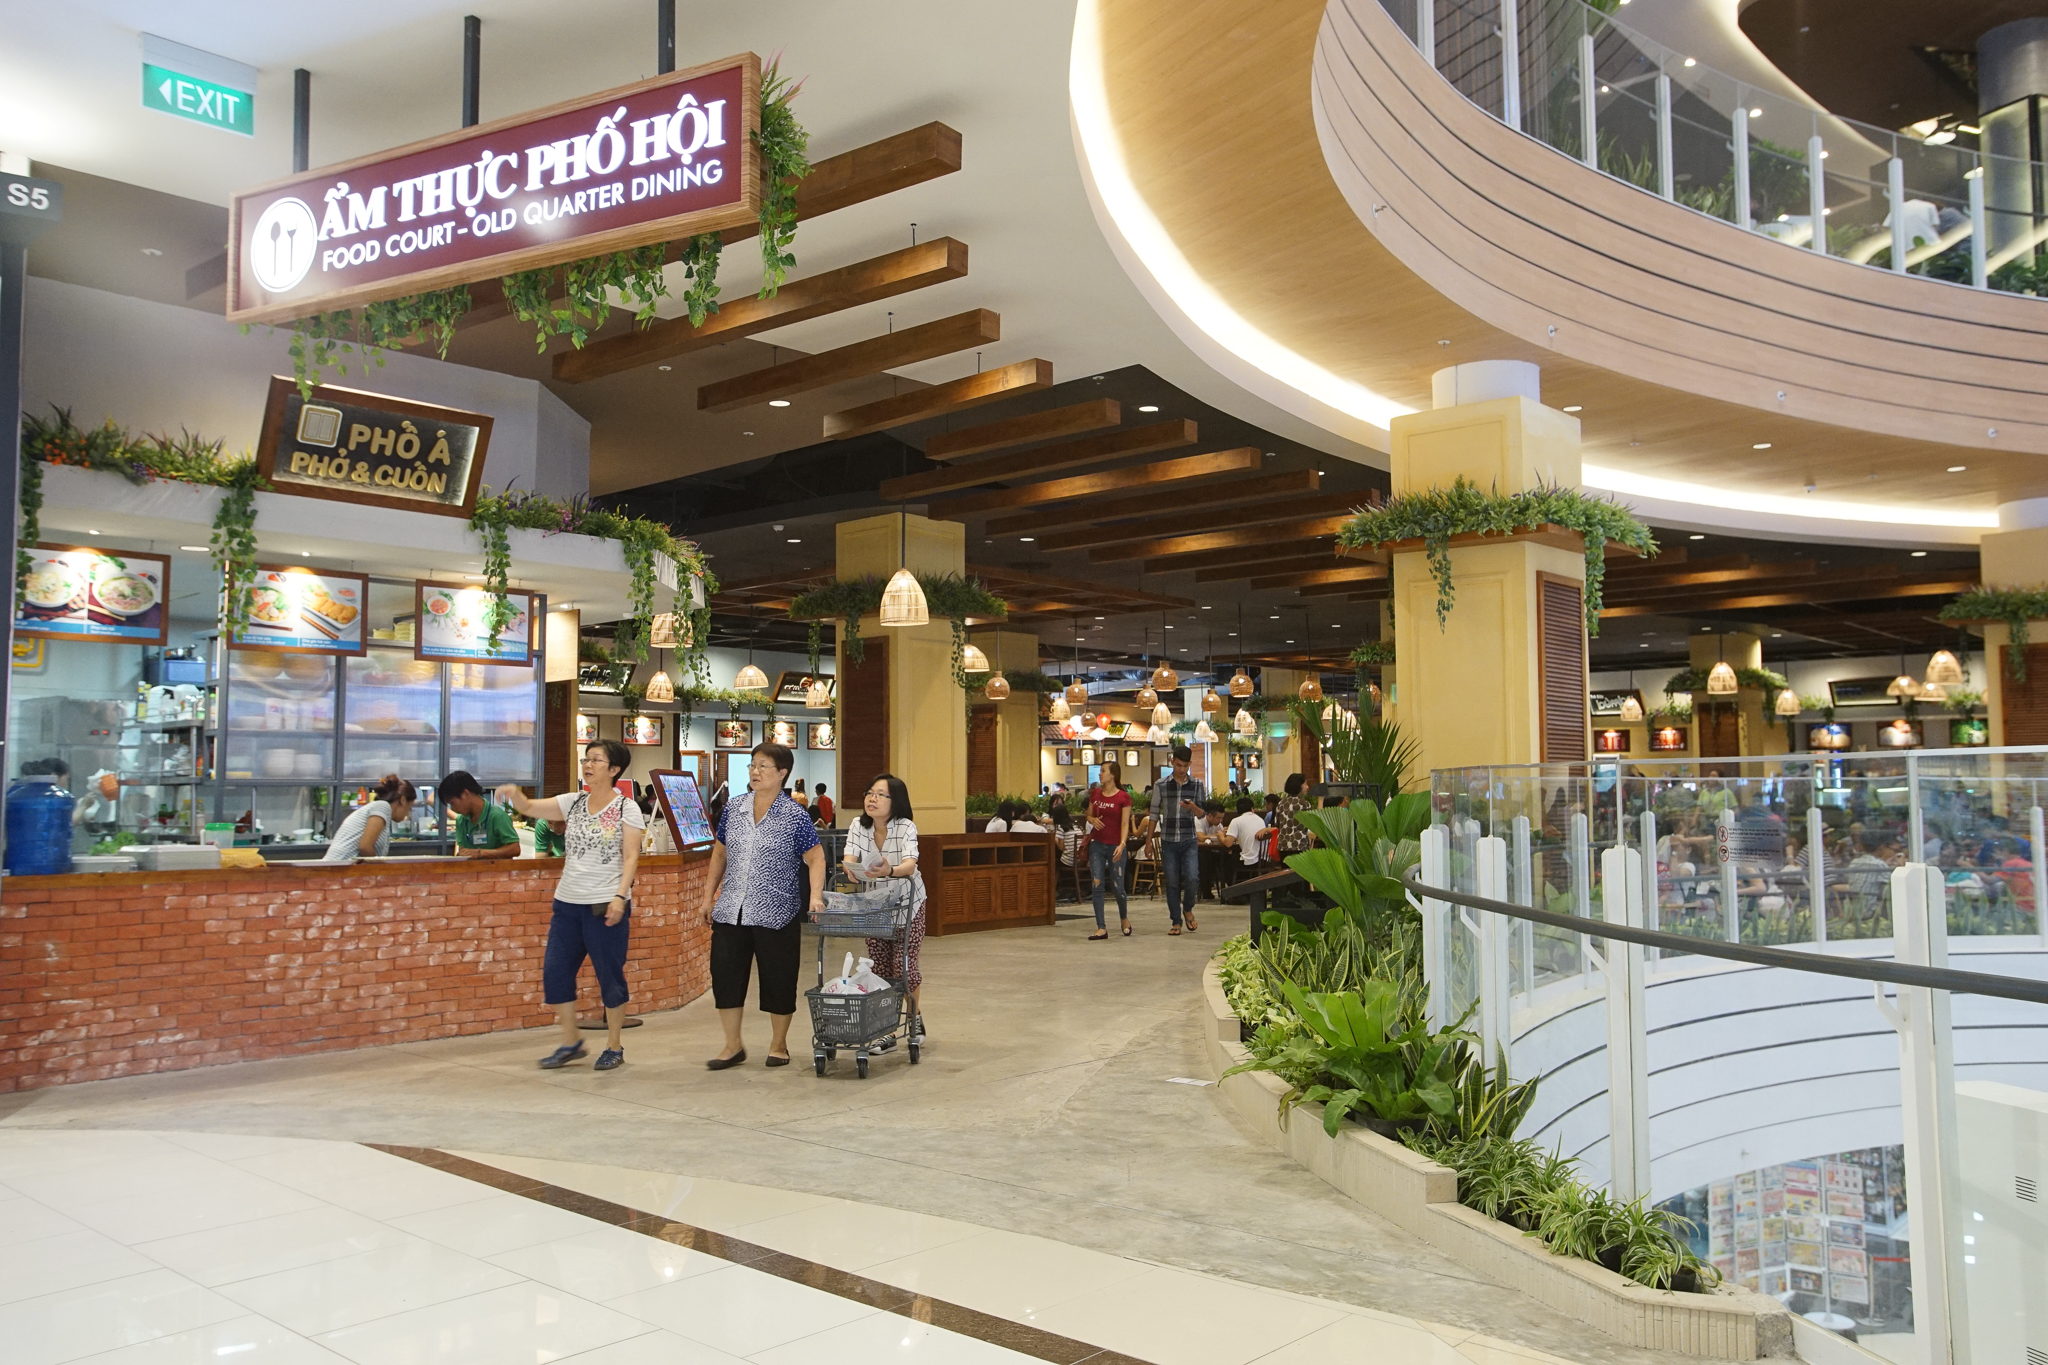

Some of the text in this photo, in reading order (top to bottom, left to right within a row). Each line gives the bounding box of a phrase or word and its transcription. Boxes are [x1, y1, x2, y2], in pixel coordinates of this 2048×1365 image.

[176, 79, 240, 125] EXIT
[317, 93, 727, 241] ẨM THỰC PHỐ HỘI
[7, 182, 51, 211] S5
[322, 239, 381, 272] FOOD
[523, 182, 625, 225] QUARTER
[631, 159, 723, 201] DINING
[290, 447, 350, 479] PHỞ
[351, 461, 370, 484] &
